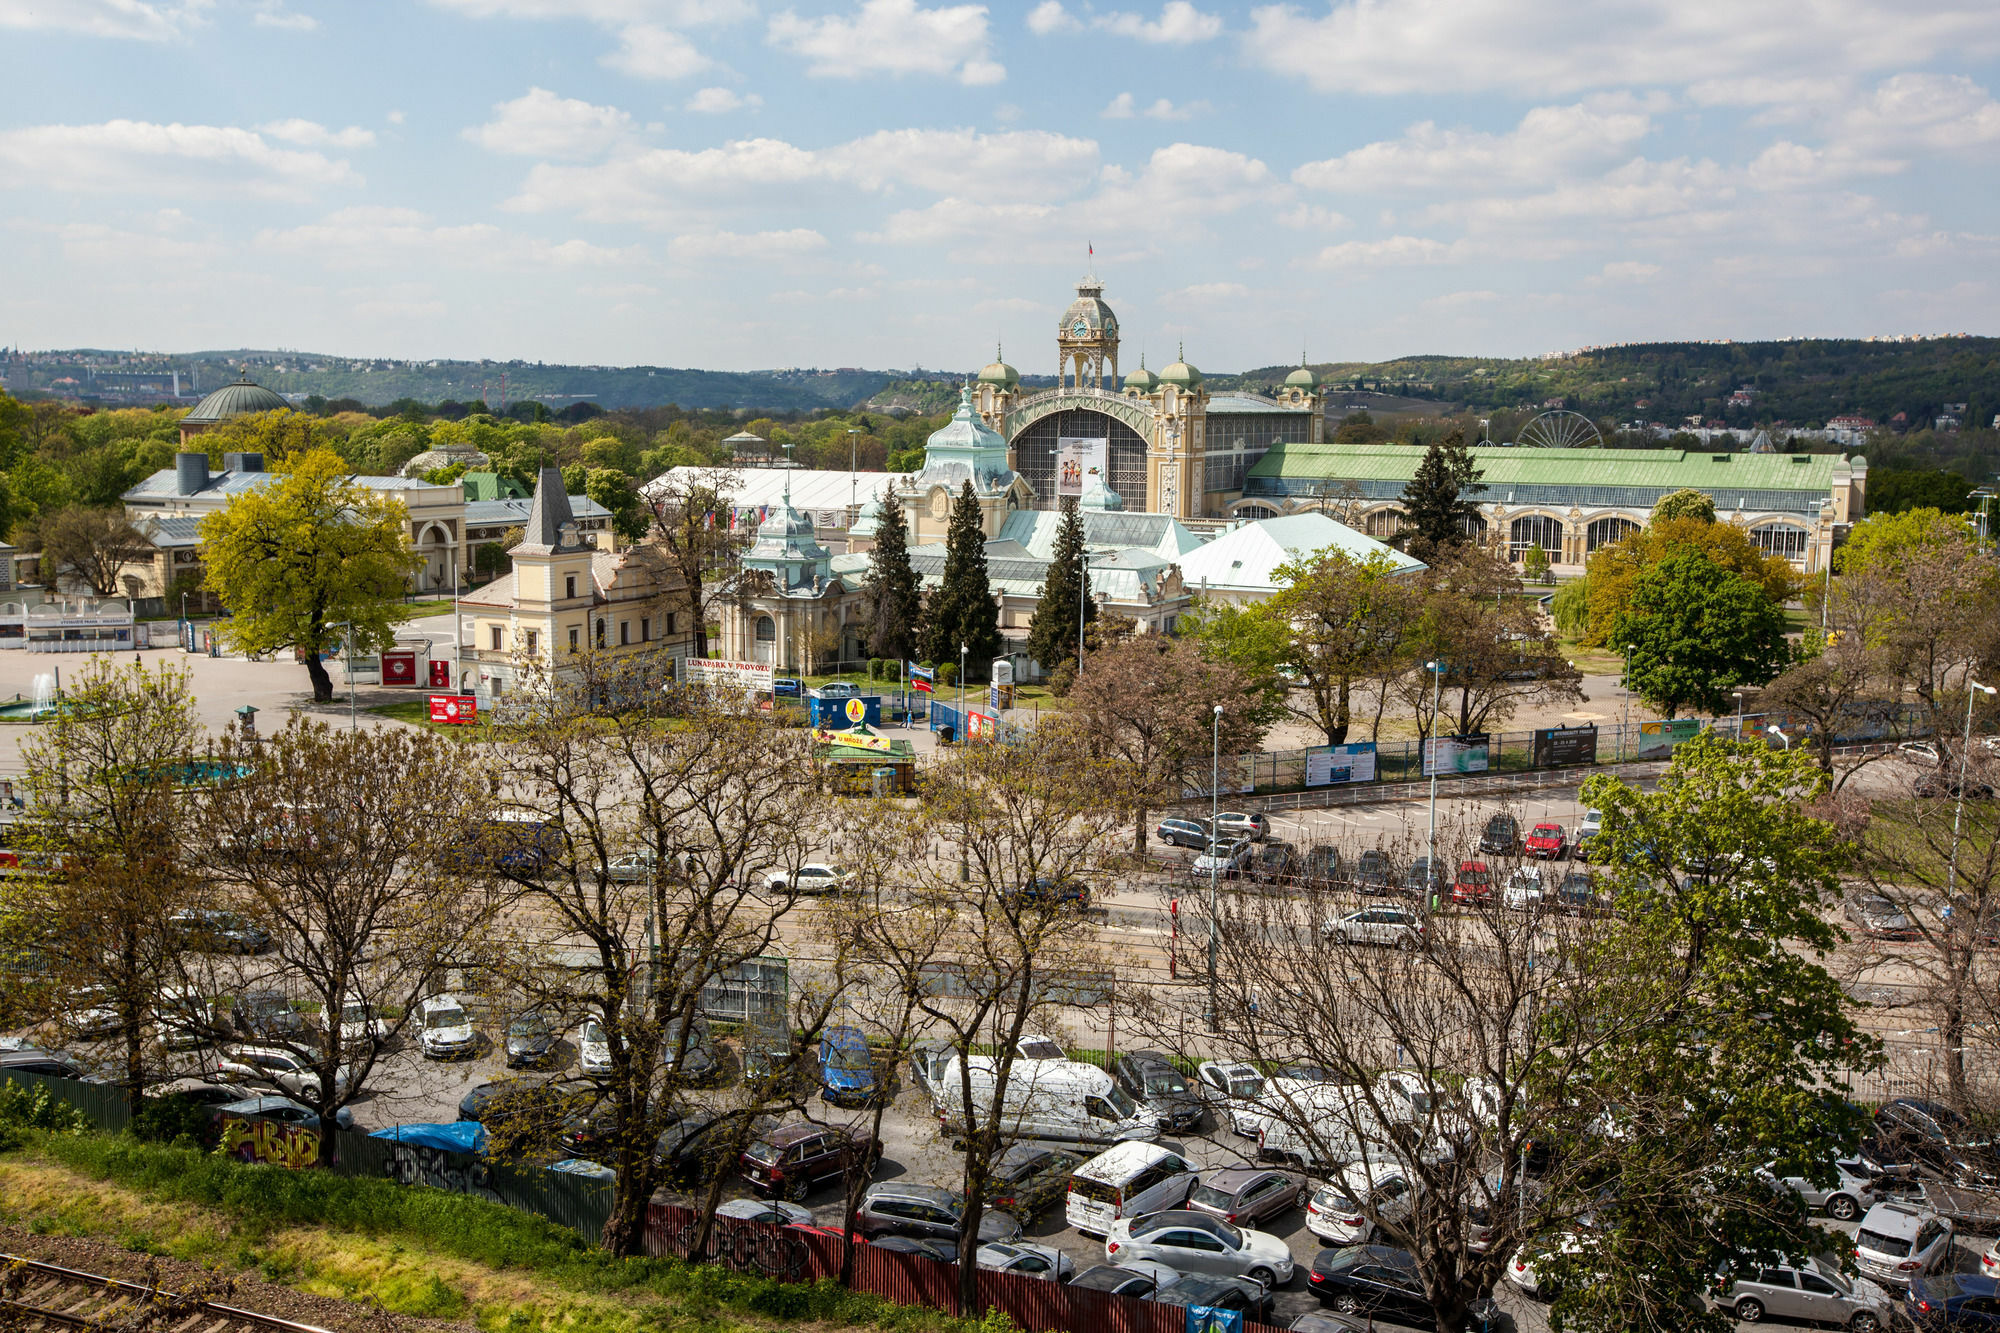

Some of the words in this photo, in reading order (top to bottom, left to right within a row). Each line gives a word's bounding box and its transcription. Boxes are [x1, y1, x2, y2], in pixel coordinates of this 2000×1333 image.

[687, 659, 726, 669] LUNAPARK
[736, 663, 771, 672] PROVOZU
[844, 737, 863, 745] MROŽE
